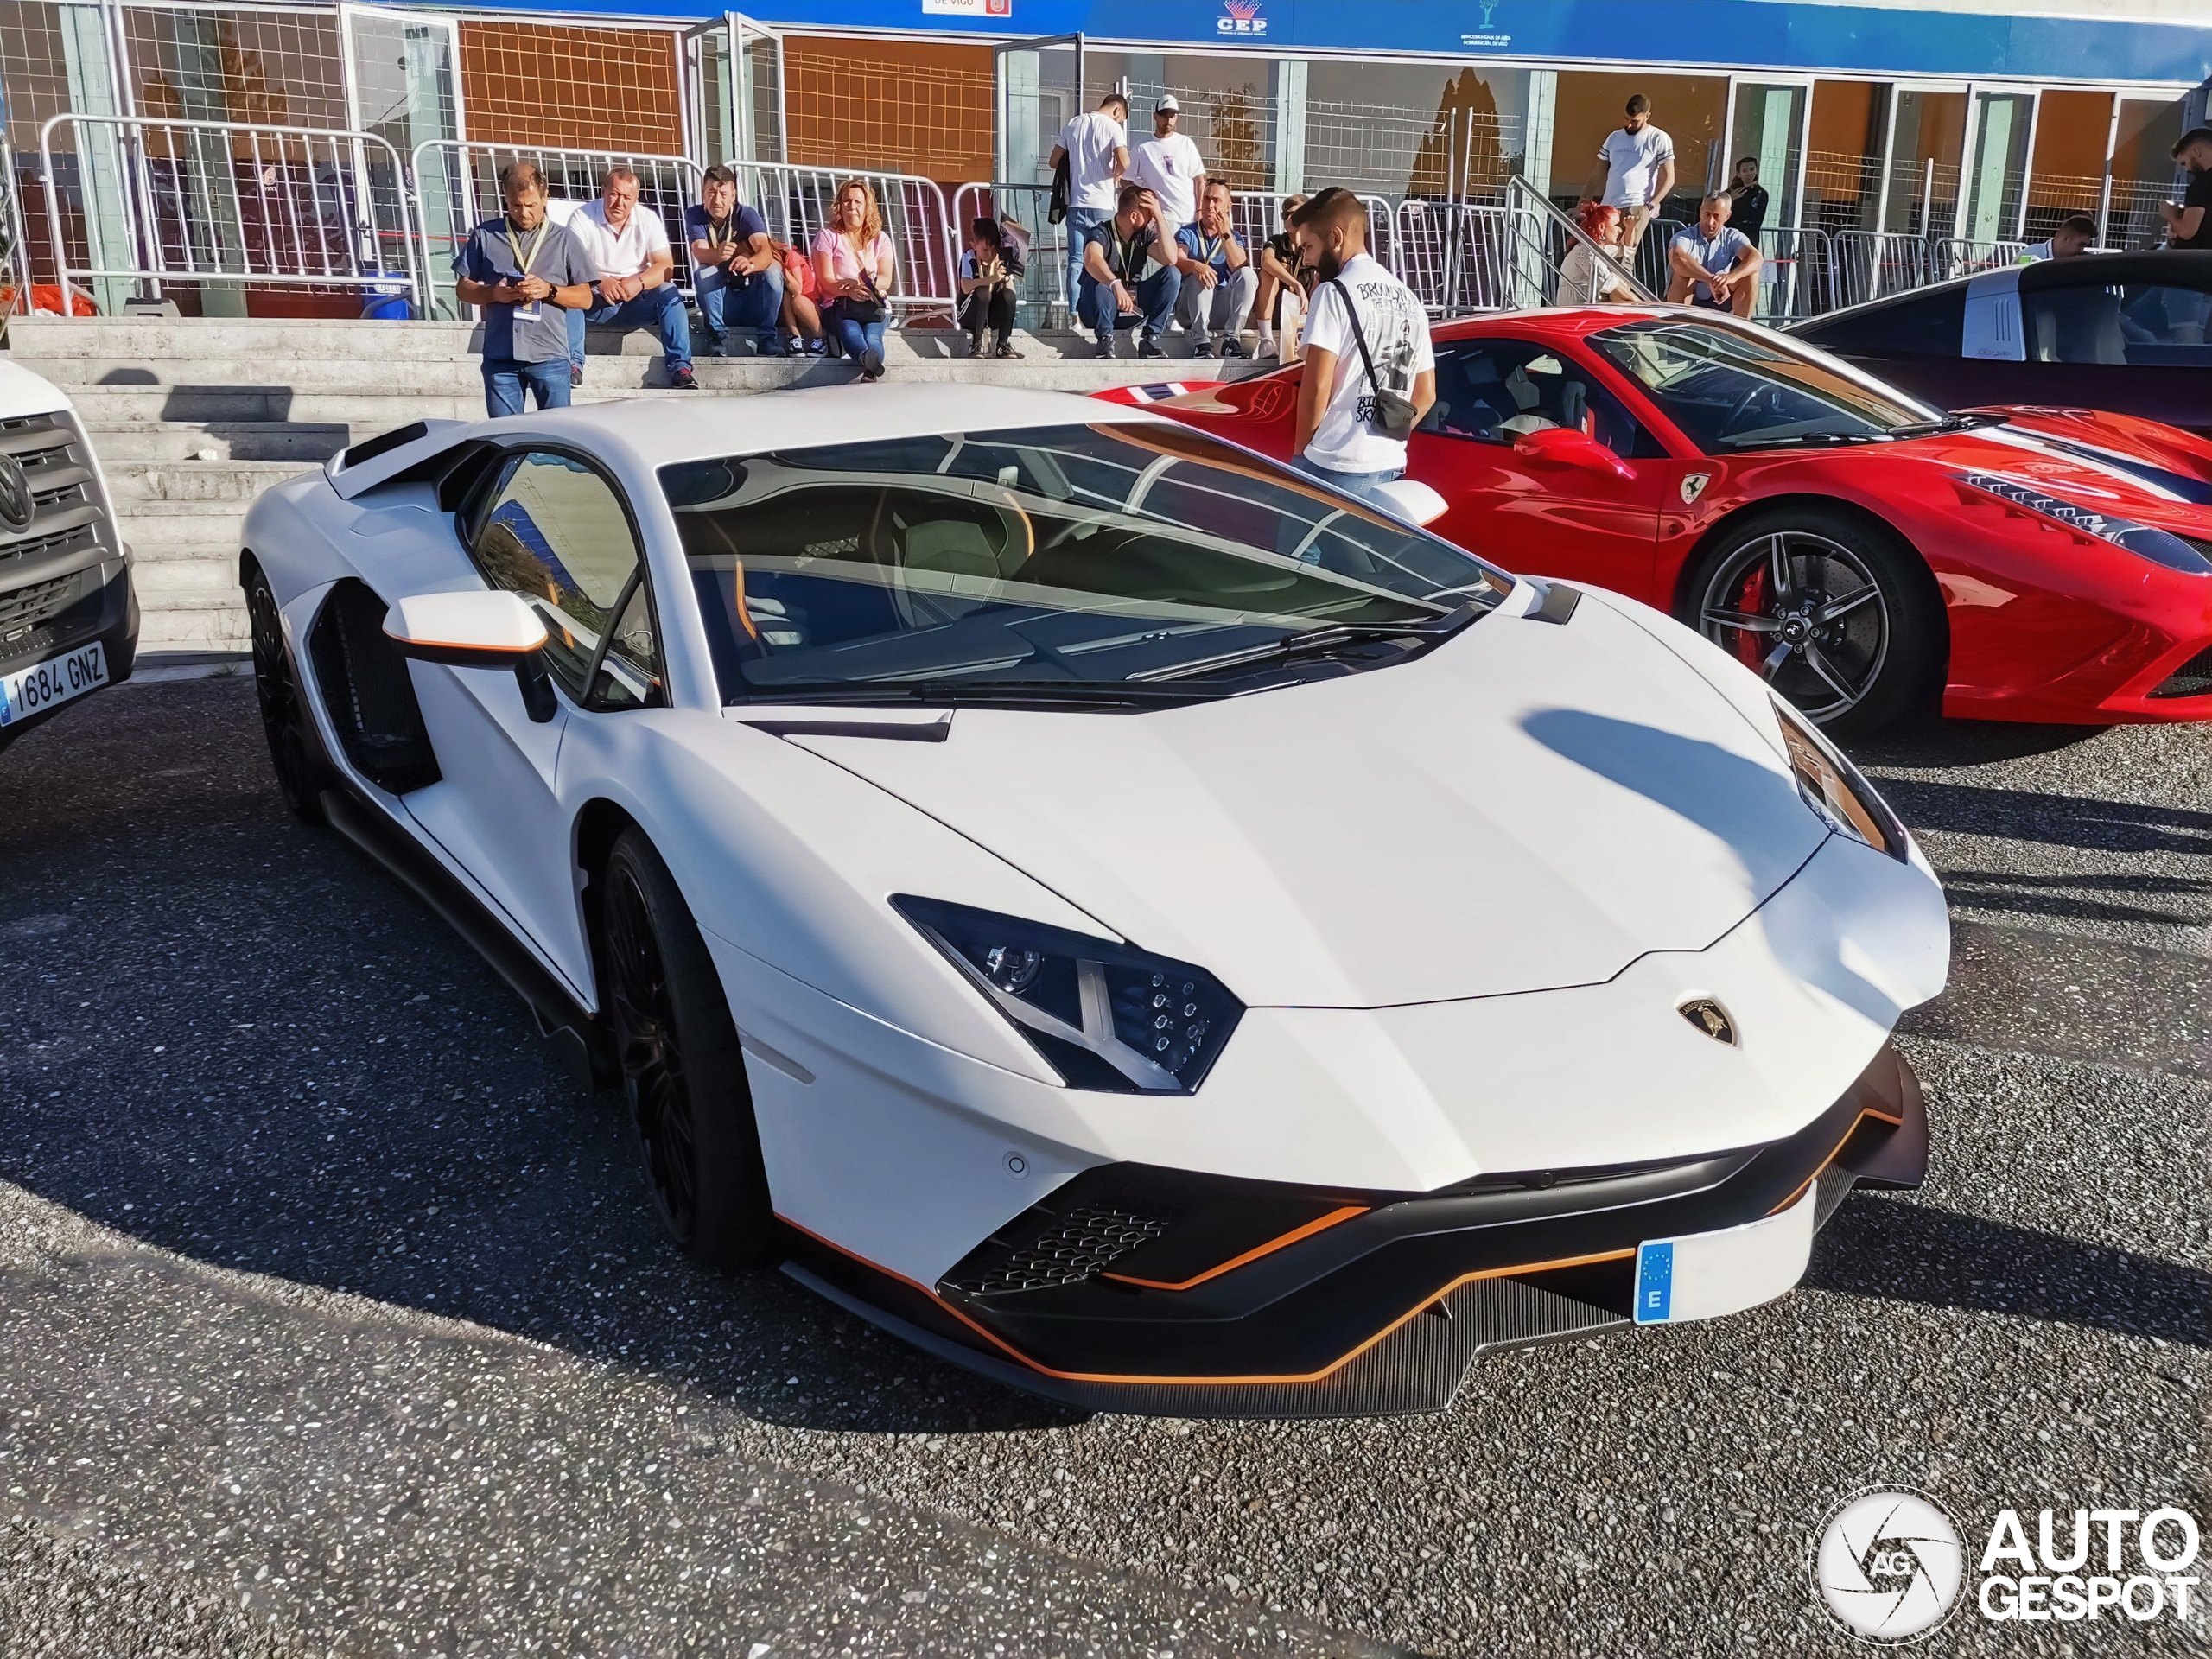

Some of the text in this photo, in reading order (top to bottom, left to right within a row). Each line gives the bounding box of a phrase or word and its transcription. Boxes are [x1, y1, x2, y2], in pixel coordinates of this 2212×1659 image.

[1217, 18, 1268, 31] CEP
[14, 647, 104, 712] 1684 GNZ
[1648, 1290, 1662, 1308] E
